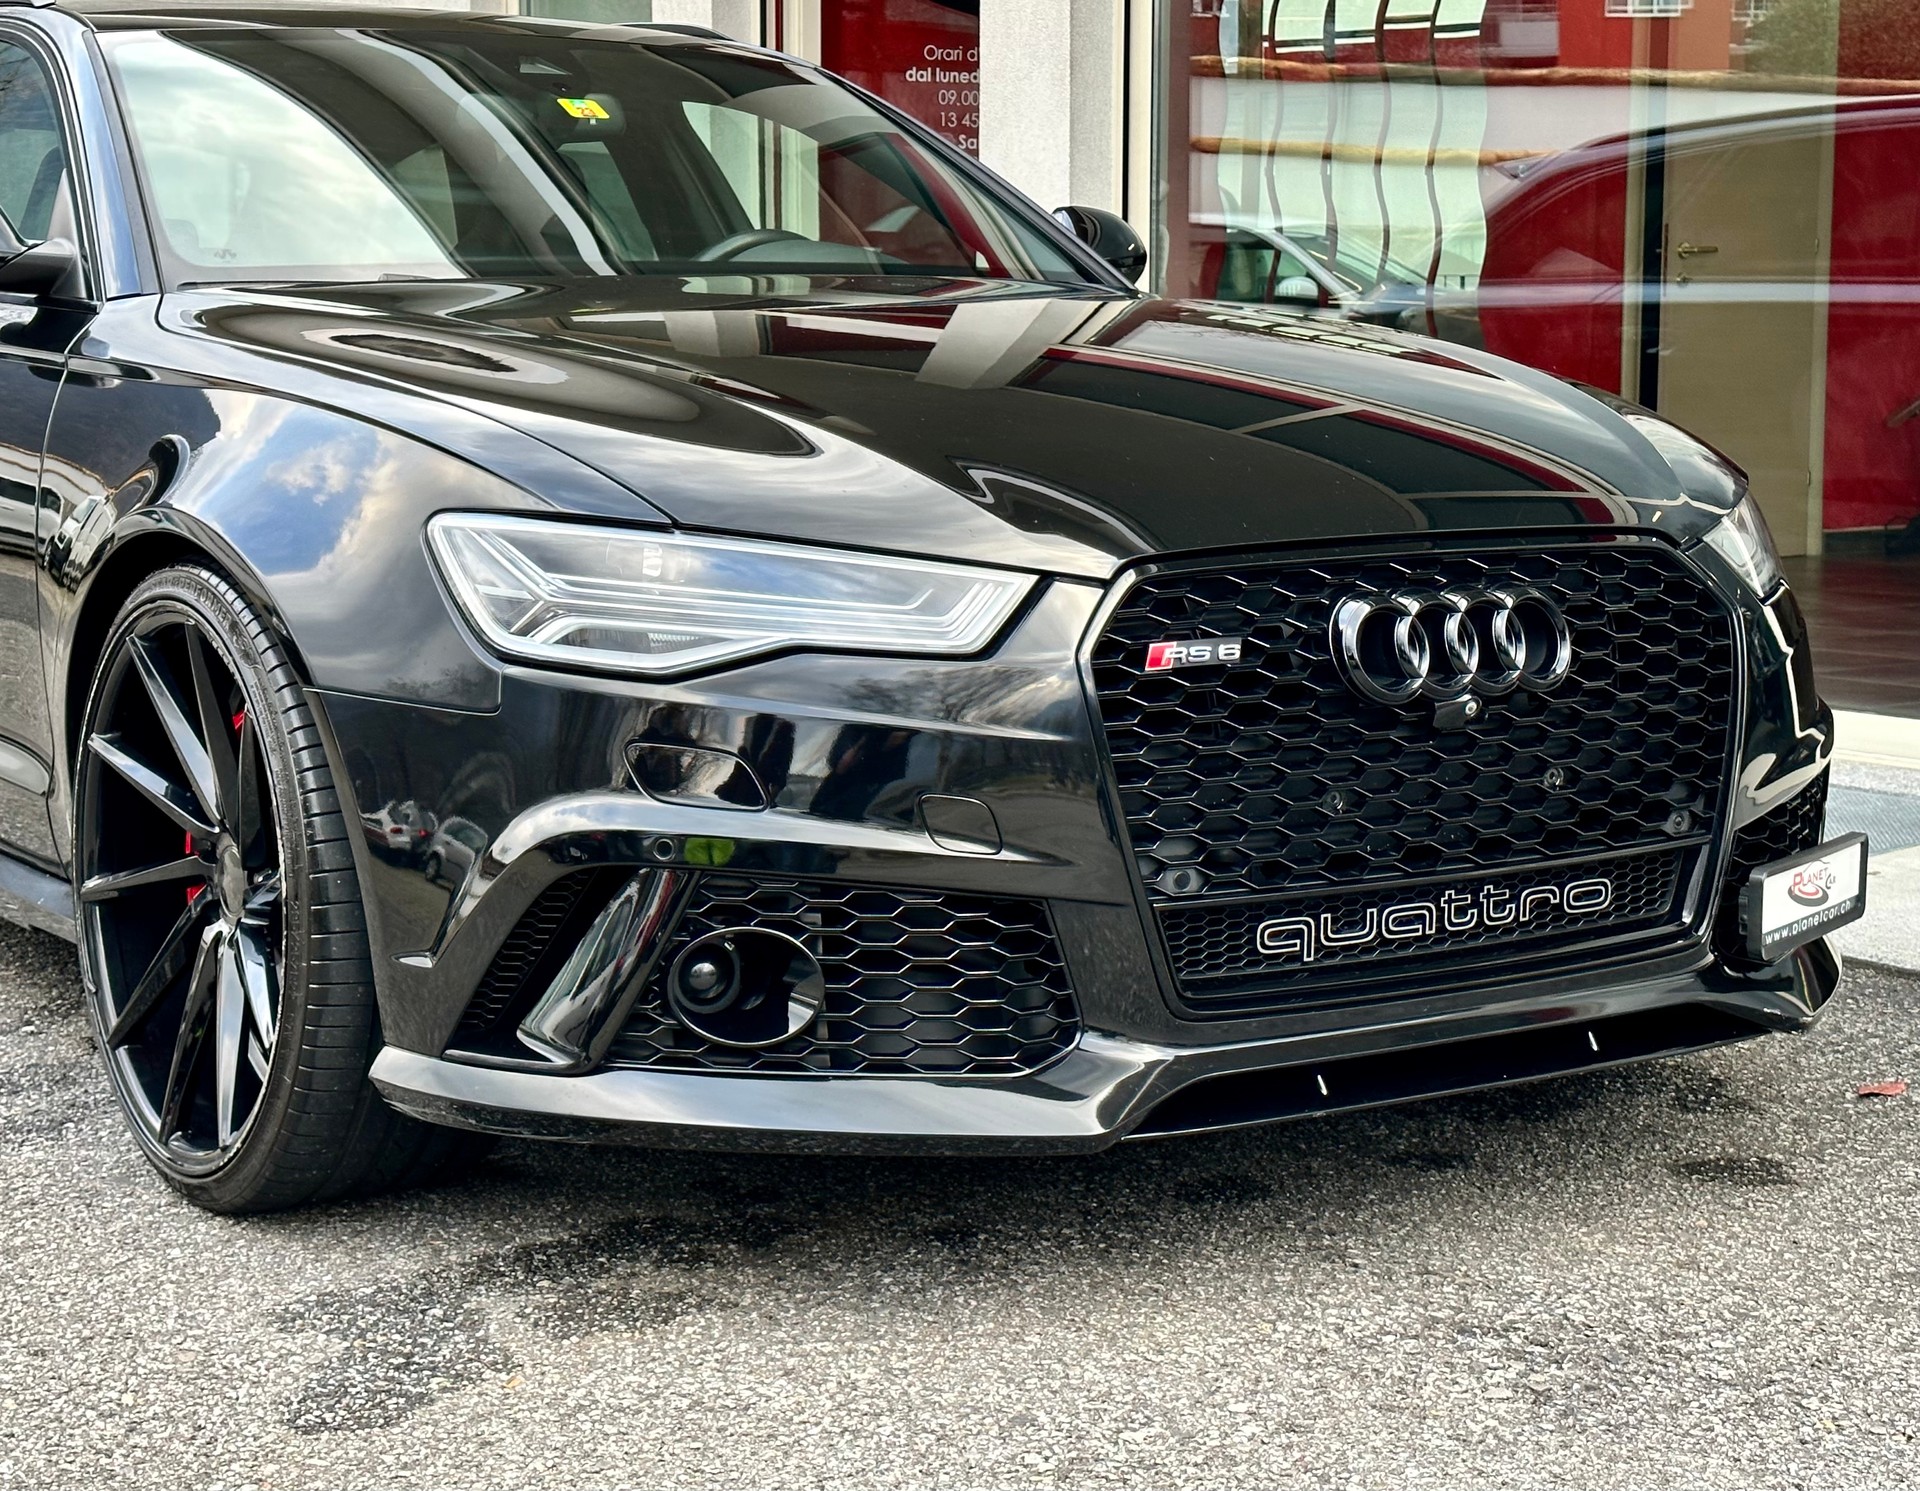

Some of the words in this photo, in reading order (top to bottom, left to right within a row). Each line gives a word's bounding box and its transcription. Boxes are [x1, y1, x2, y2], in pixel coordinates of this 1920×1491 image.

[923, 44, 963, 61] Orari
[905, 66, 932, 82] dal
[938, 89, 979, 106] 09.00
[940, 111, 957, 127] 13
[961, 112, 979, 128] 45
[1792, 867, 1828, 896] PLANET
[1256, 877, 1611, 962] quattro
